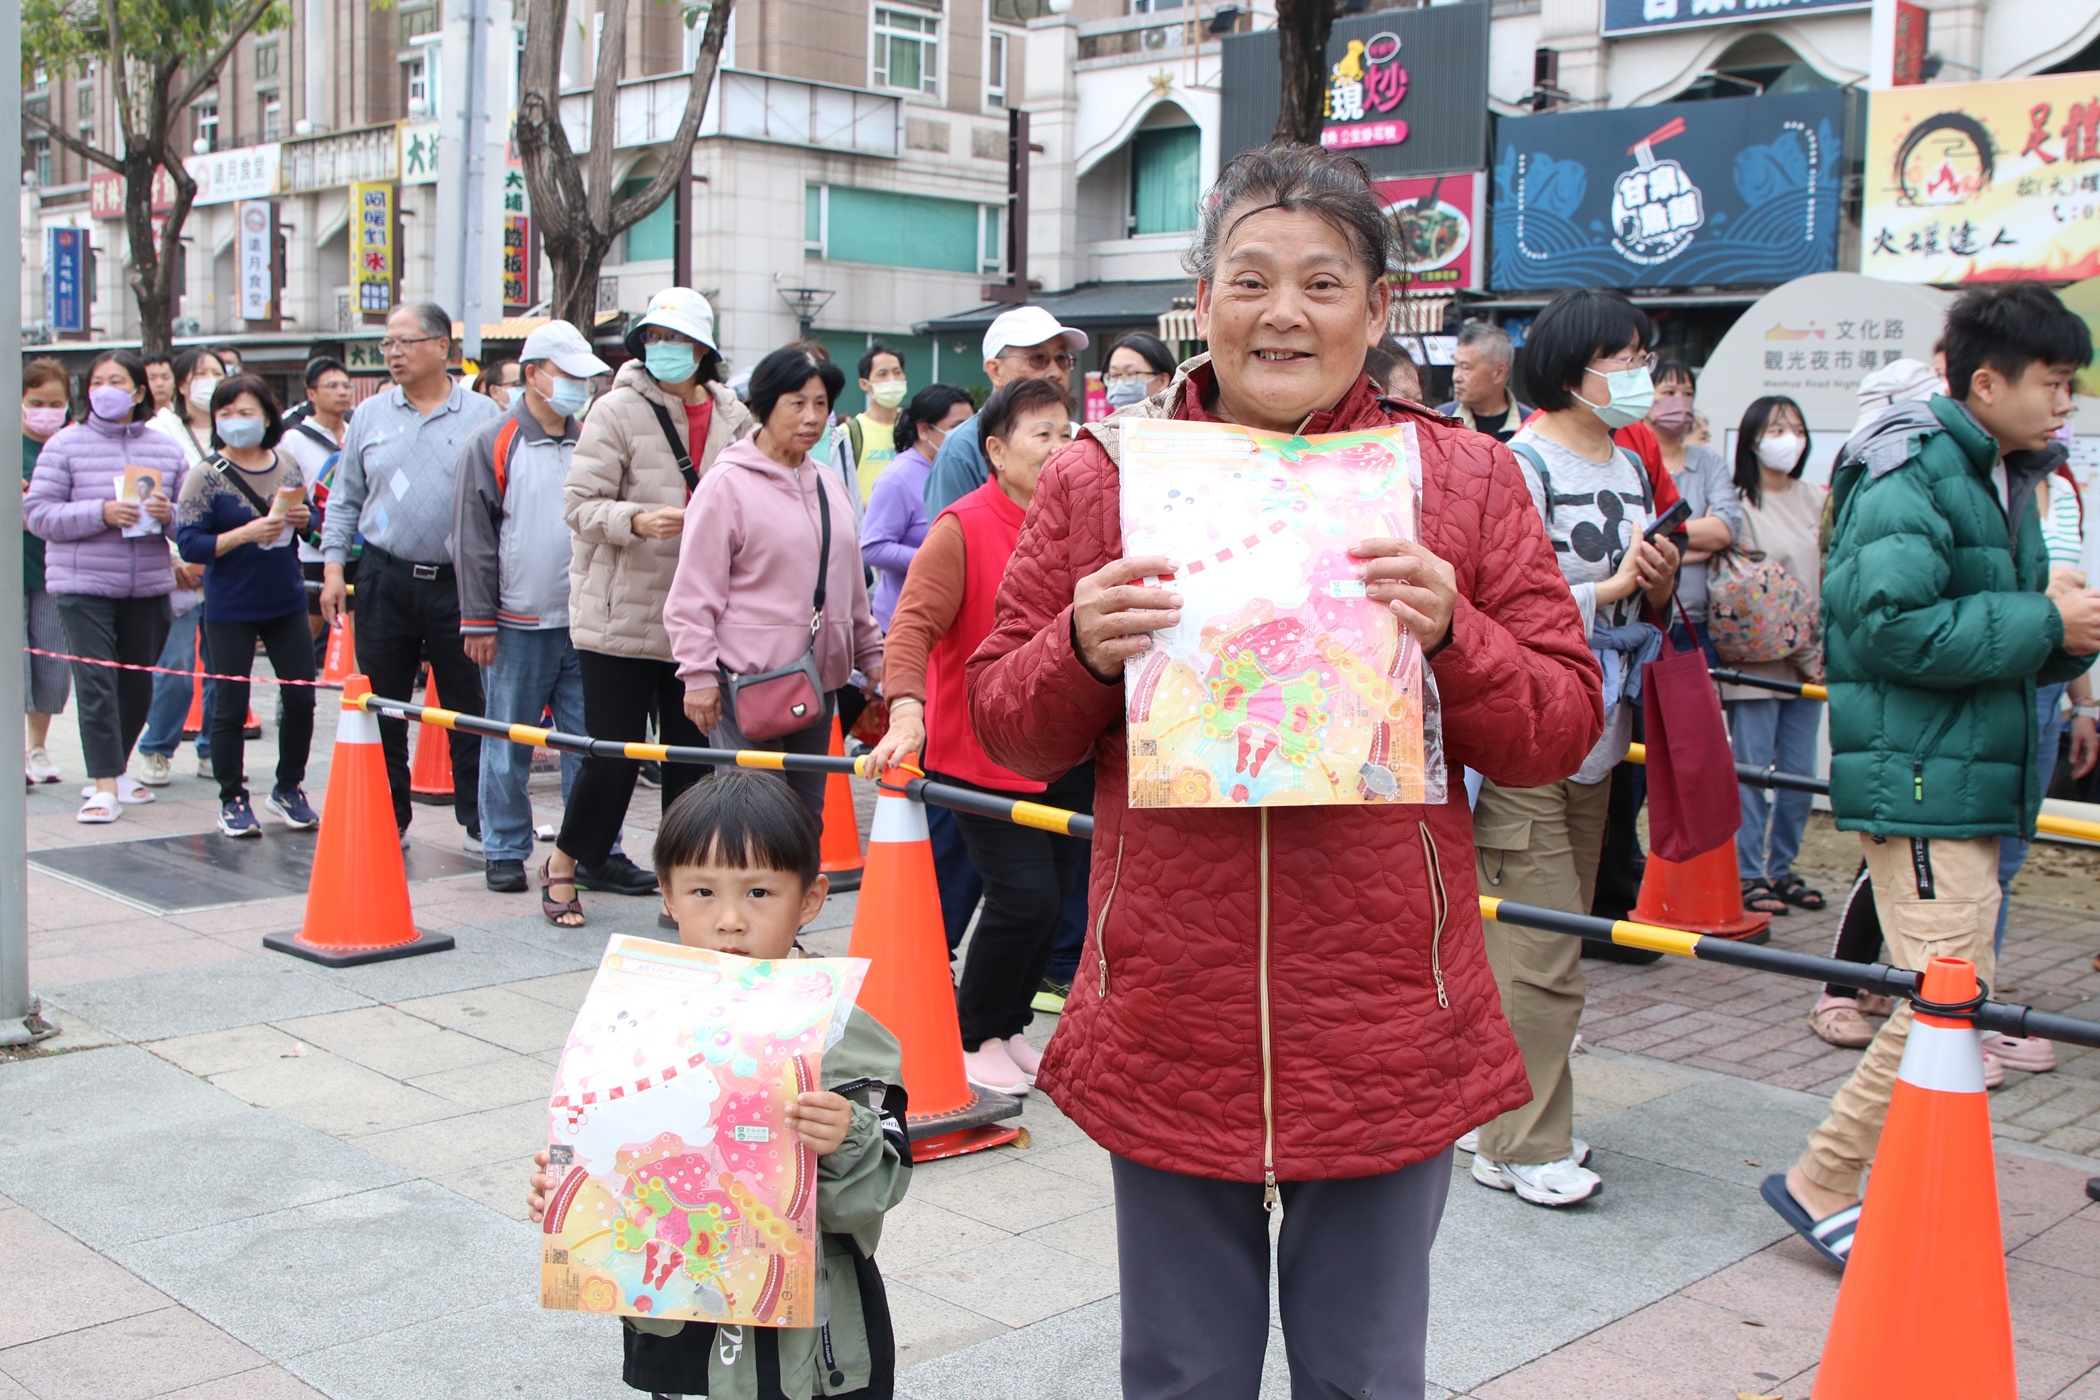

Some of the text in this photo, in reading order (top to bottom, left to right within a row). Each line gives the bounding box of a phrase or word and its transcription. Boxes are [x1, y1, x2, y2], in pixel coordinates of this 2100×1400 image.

[1331, 62, 1409, 121] 現炒
[1836, 319, 1904, 341] 文化路
